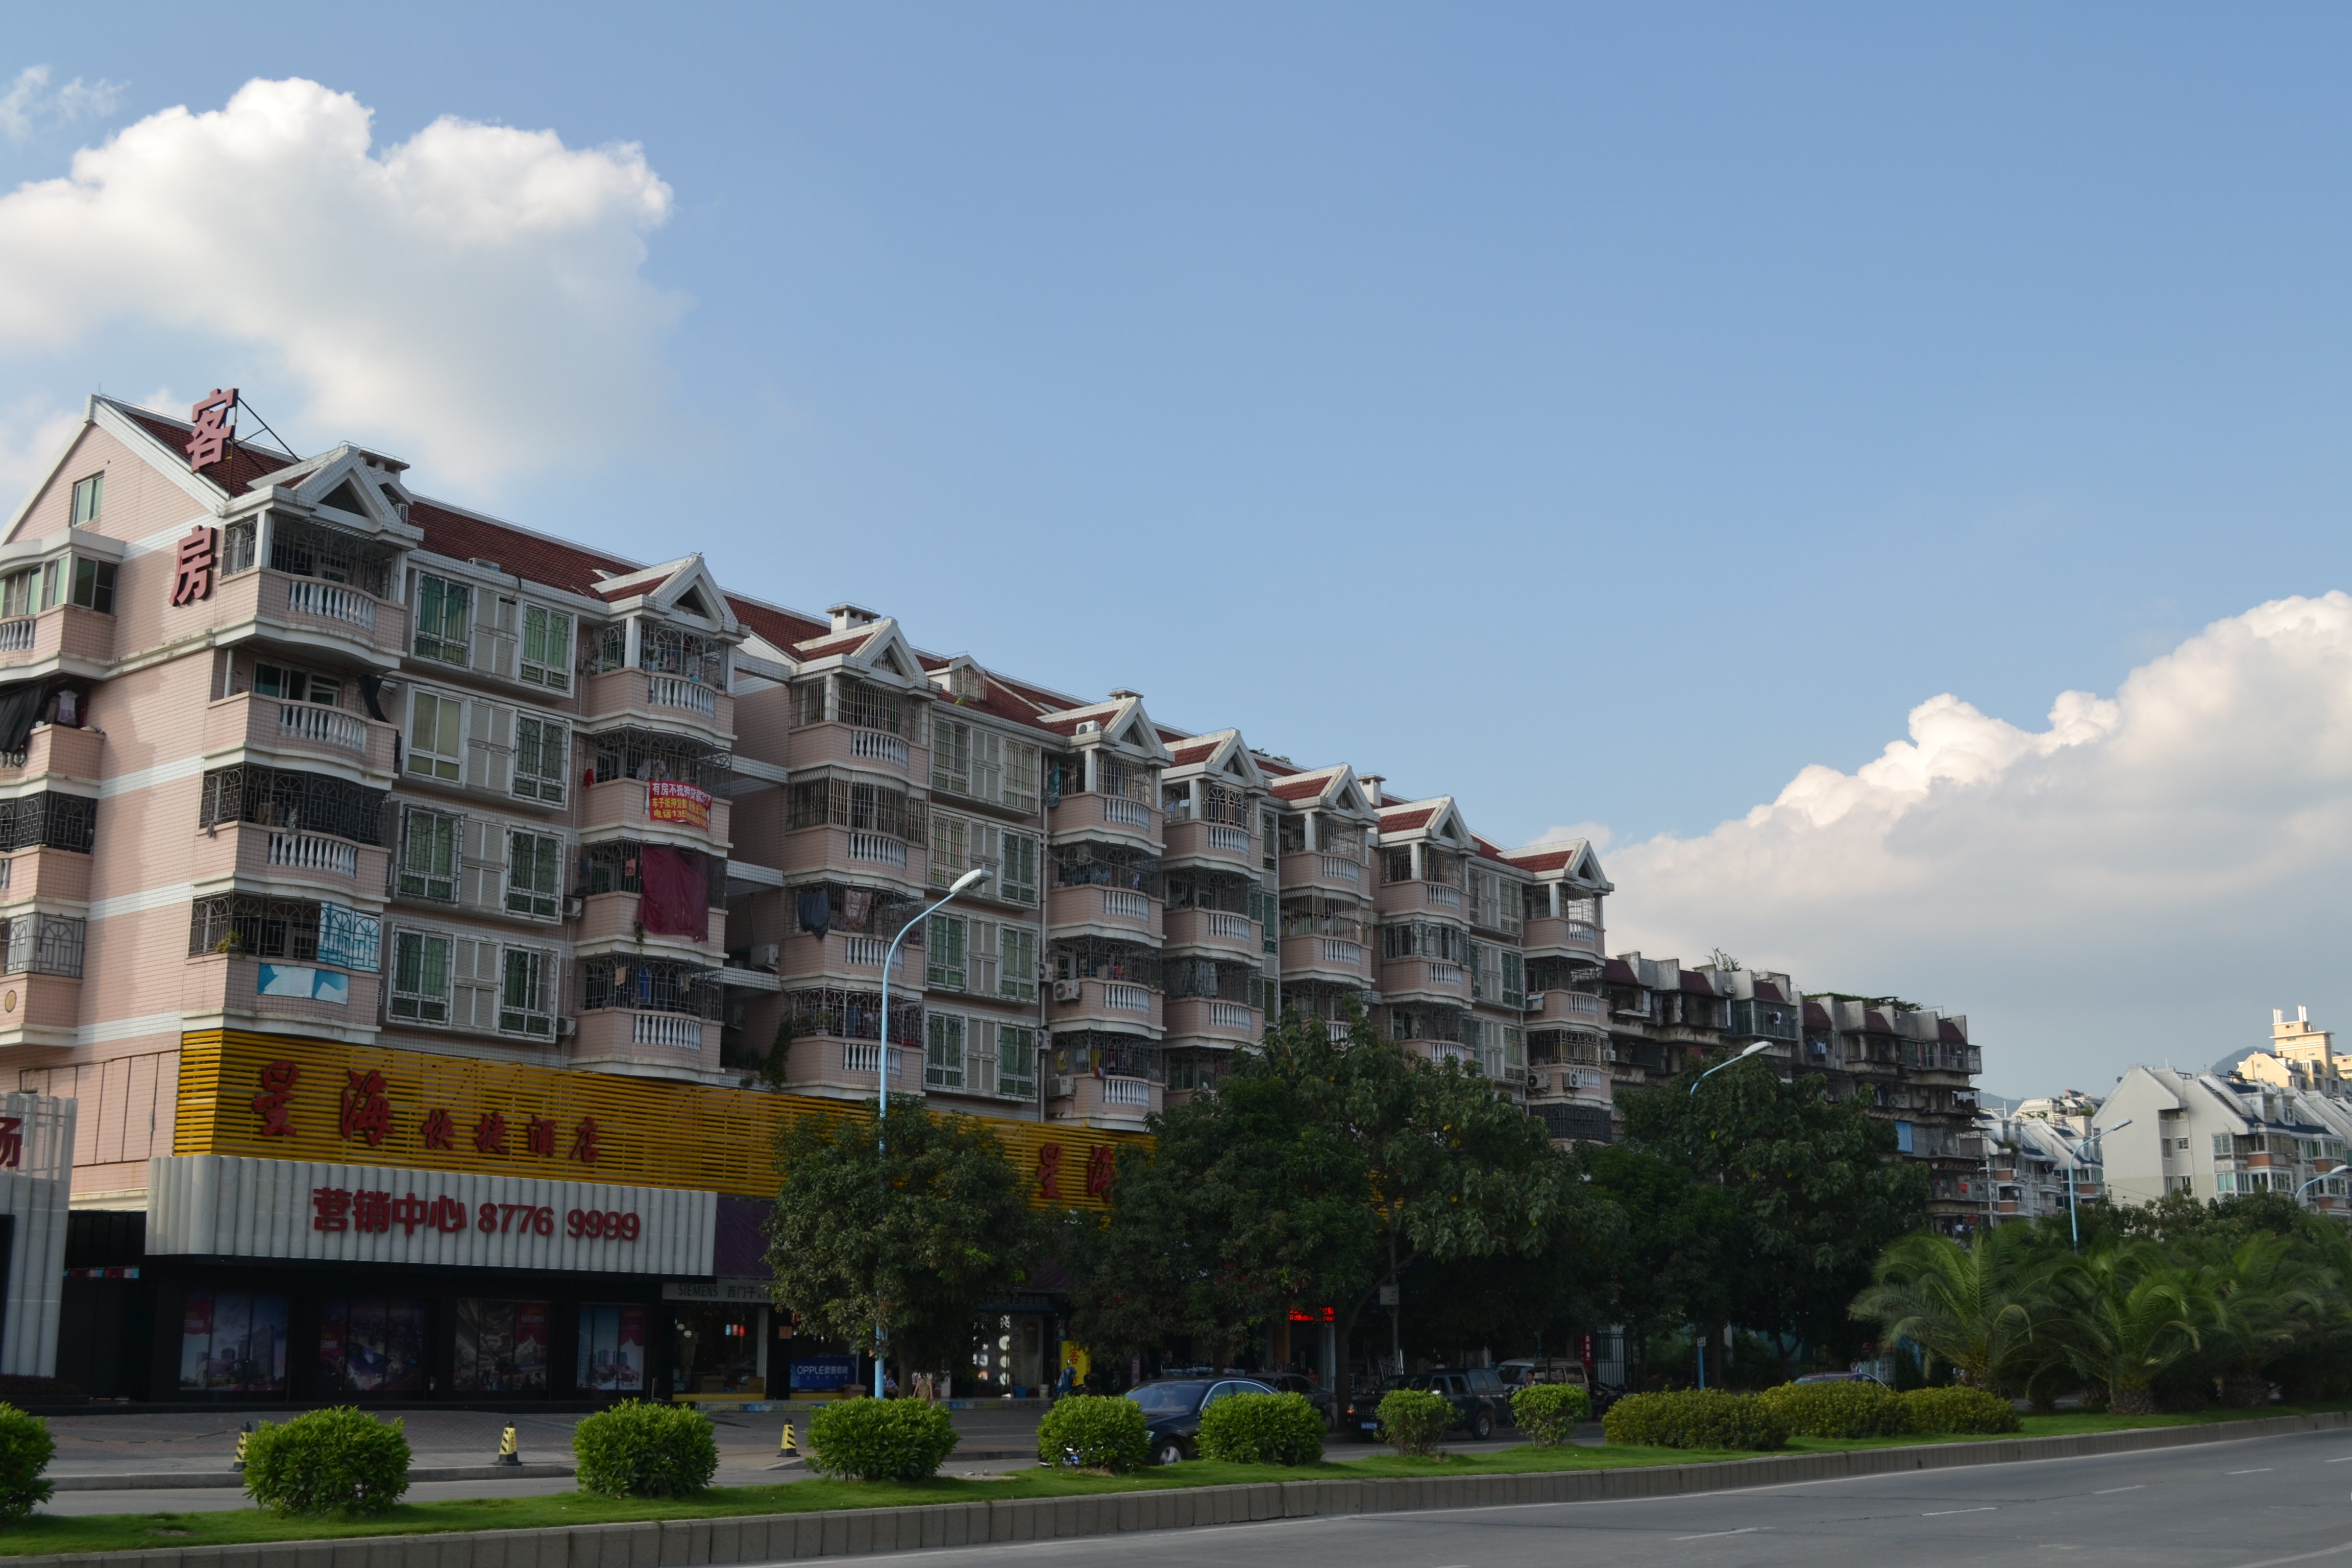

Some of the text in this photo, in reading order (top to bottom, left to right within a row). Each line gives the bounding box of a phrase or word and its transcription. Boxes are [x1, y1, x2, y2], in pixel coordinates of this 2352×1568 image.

[168, 388, 239, 607] 客房
[313, 1187, 640, 1241] 营销中心 8776 9999
[678, 1283, 718, 1297] SIEMENS
[727, 1286, 756, 1299] 西门子
